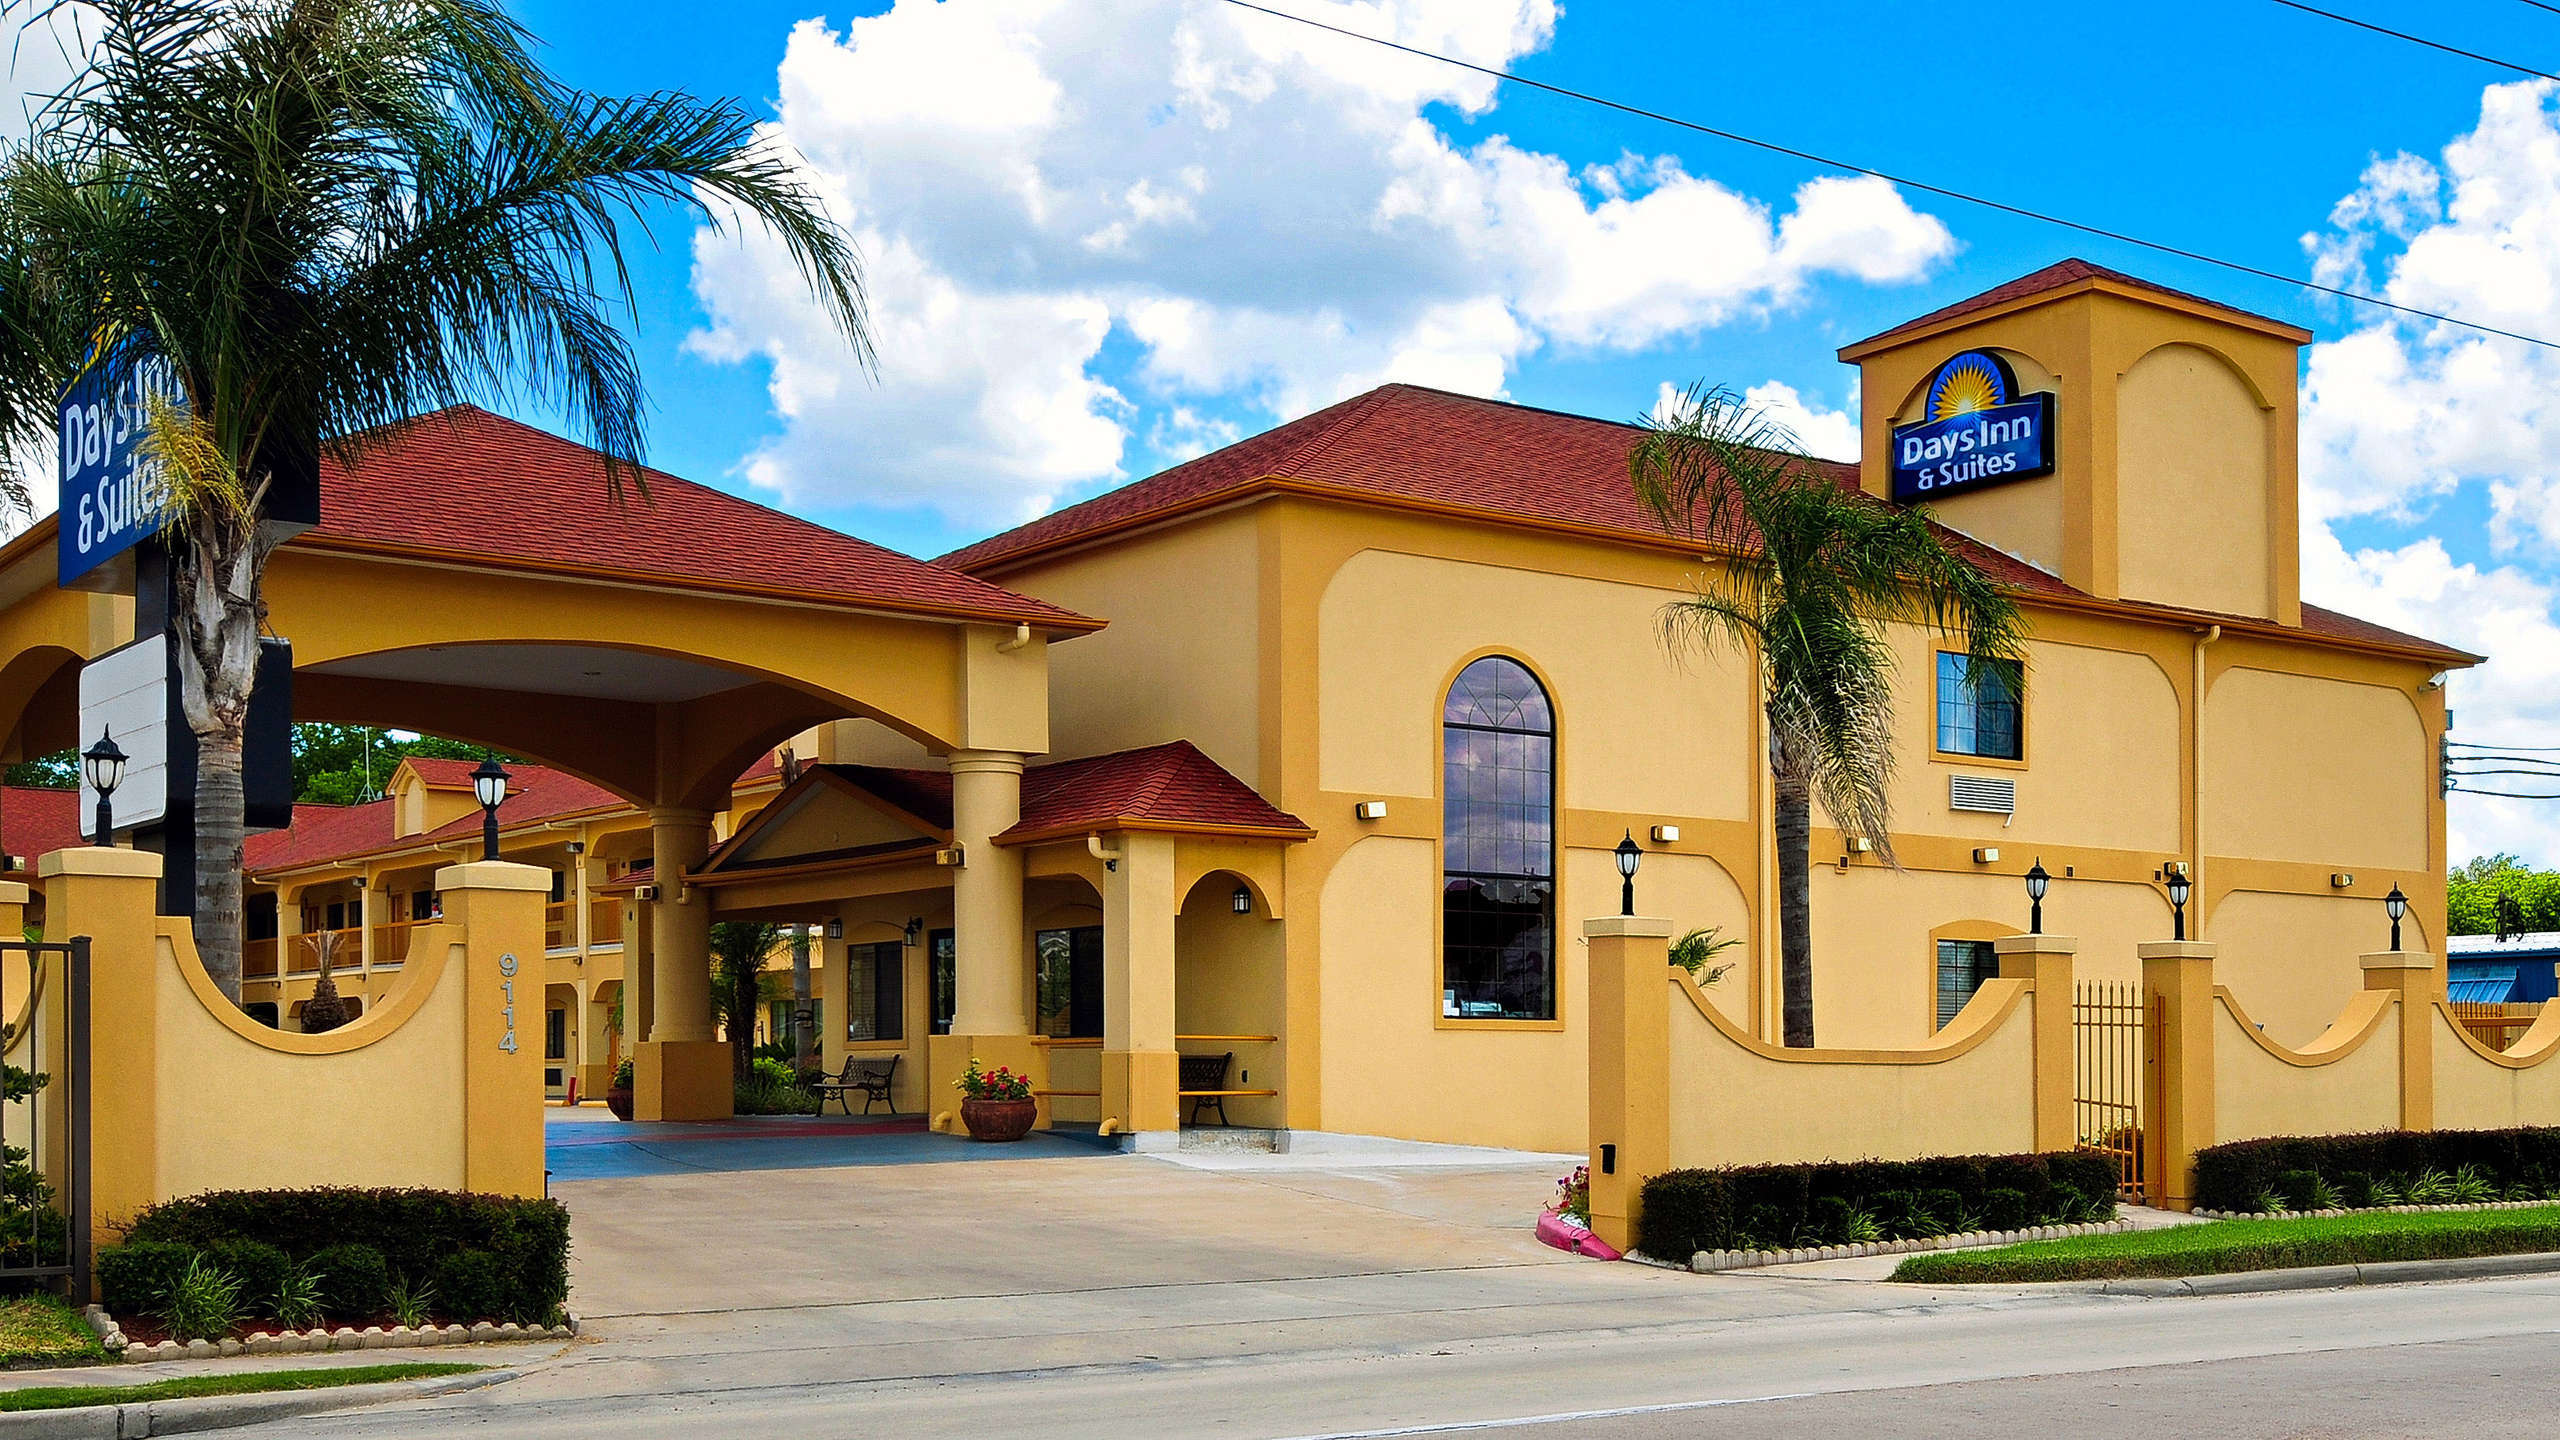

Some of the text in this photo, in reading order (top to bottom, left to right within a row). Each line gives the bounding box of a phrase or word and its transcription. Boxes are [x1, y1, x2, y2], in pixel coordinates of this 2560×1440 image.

[65, 379, 130, 482] Days
[1903, 416, 2031, 466] Days Inn
[1918, 452, 2016, 490] & Suites
[78, 453, 169, 554] & Suites
[499, 952, 518, 1055] 9114
